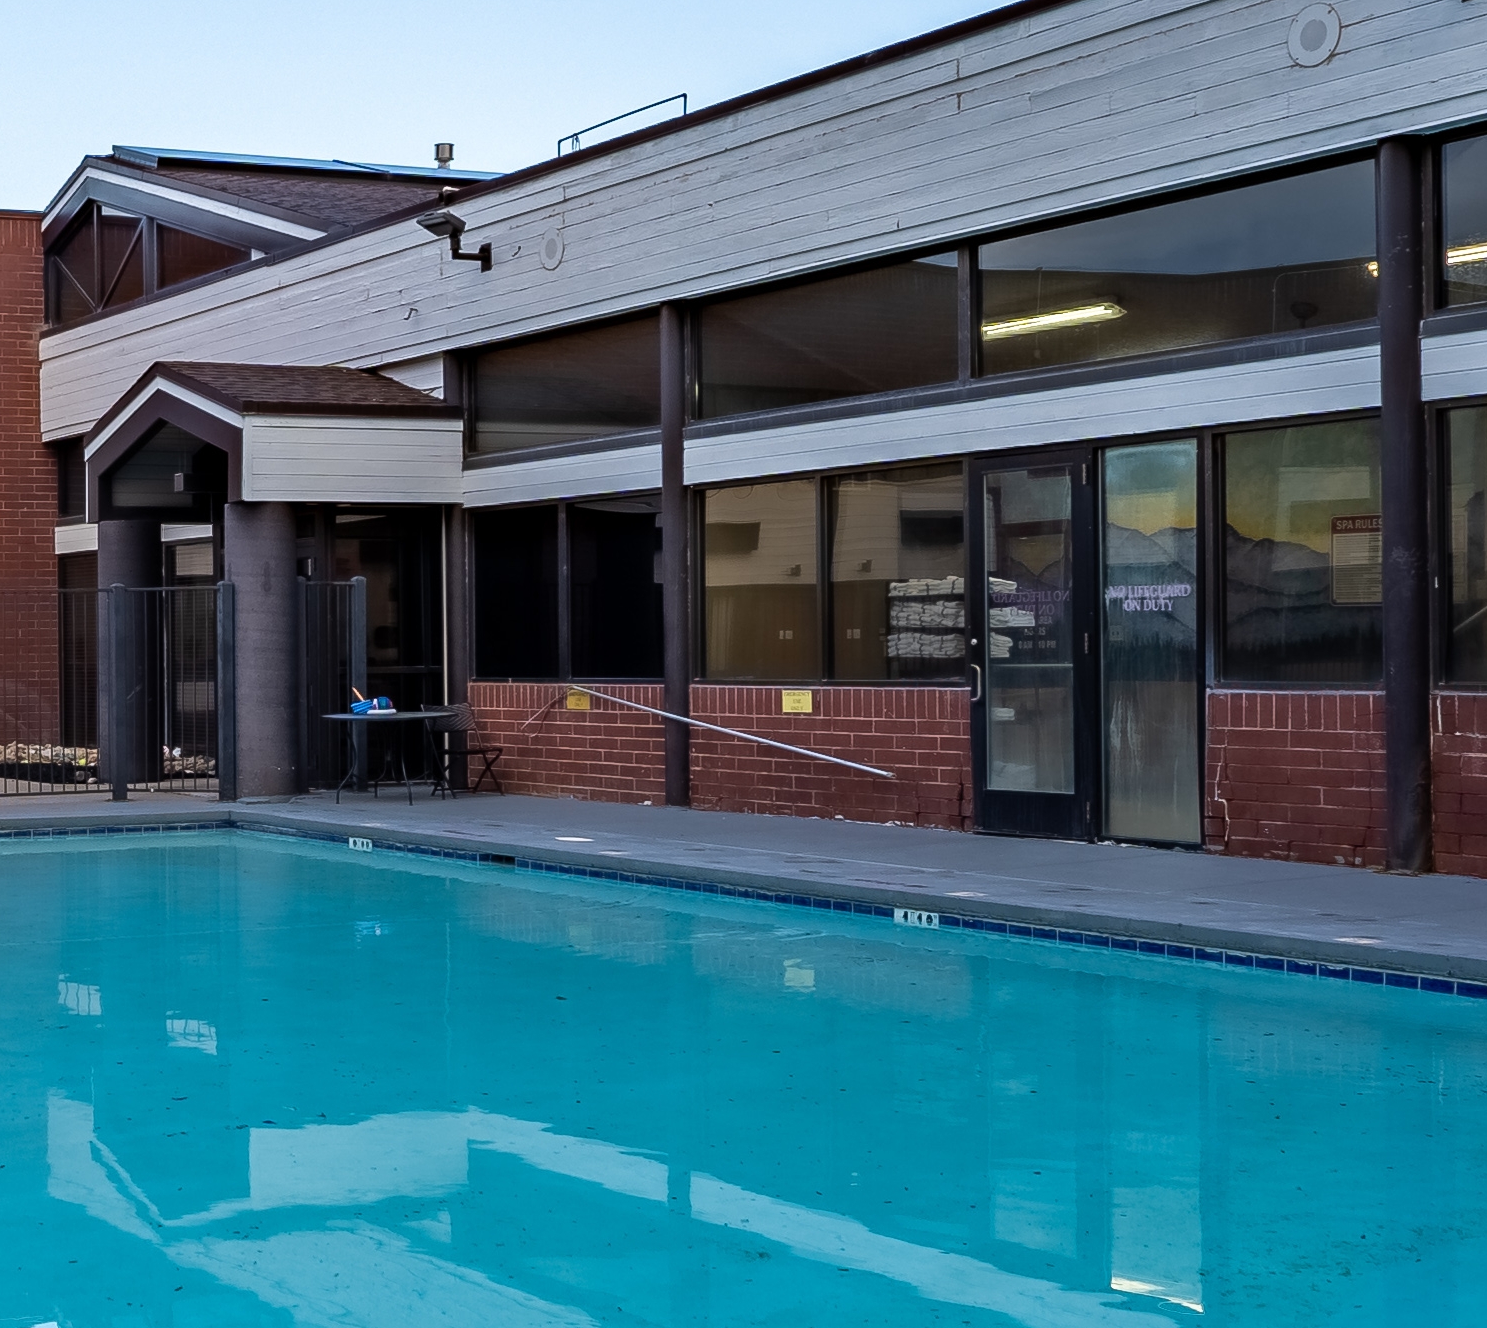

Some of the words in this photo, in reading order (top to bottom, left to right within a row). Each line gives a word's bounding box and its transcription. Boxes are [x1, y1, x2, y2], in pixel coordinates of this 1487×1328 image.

[1336, 520, 1354, 530] SPA
[1108, 585, 1126, 599] NO
[1128, 583, 1191, 598] LIFEGUARD
[1124, 599, 1141, 612] ON
[1144, 599, 1174, 611] DUTY
